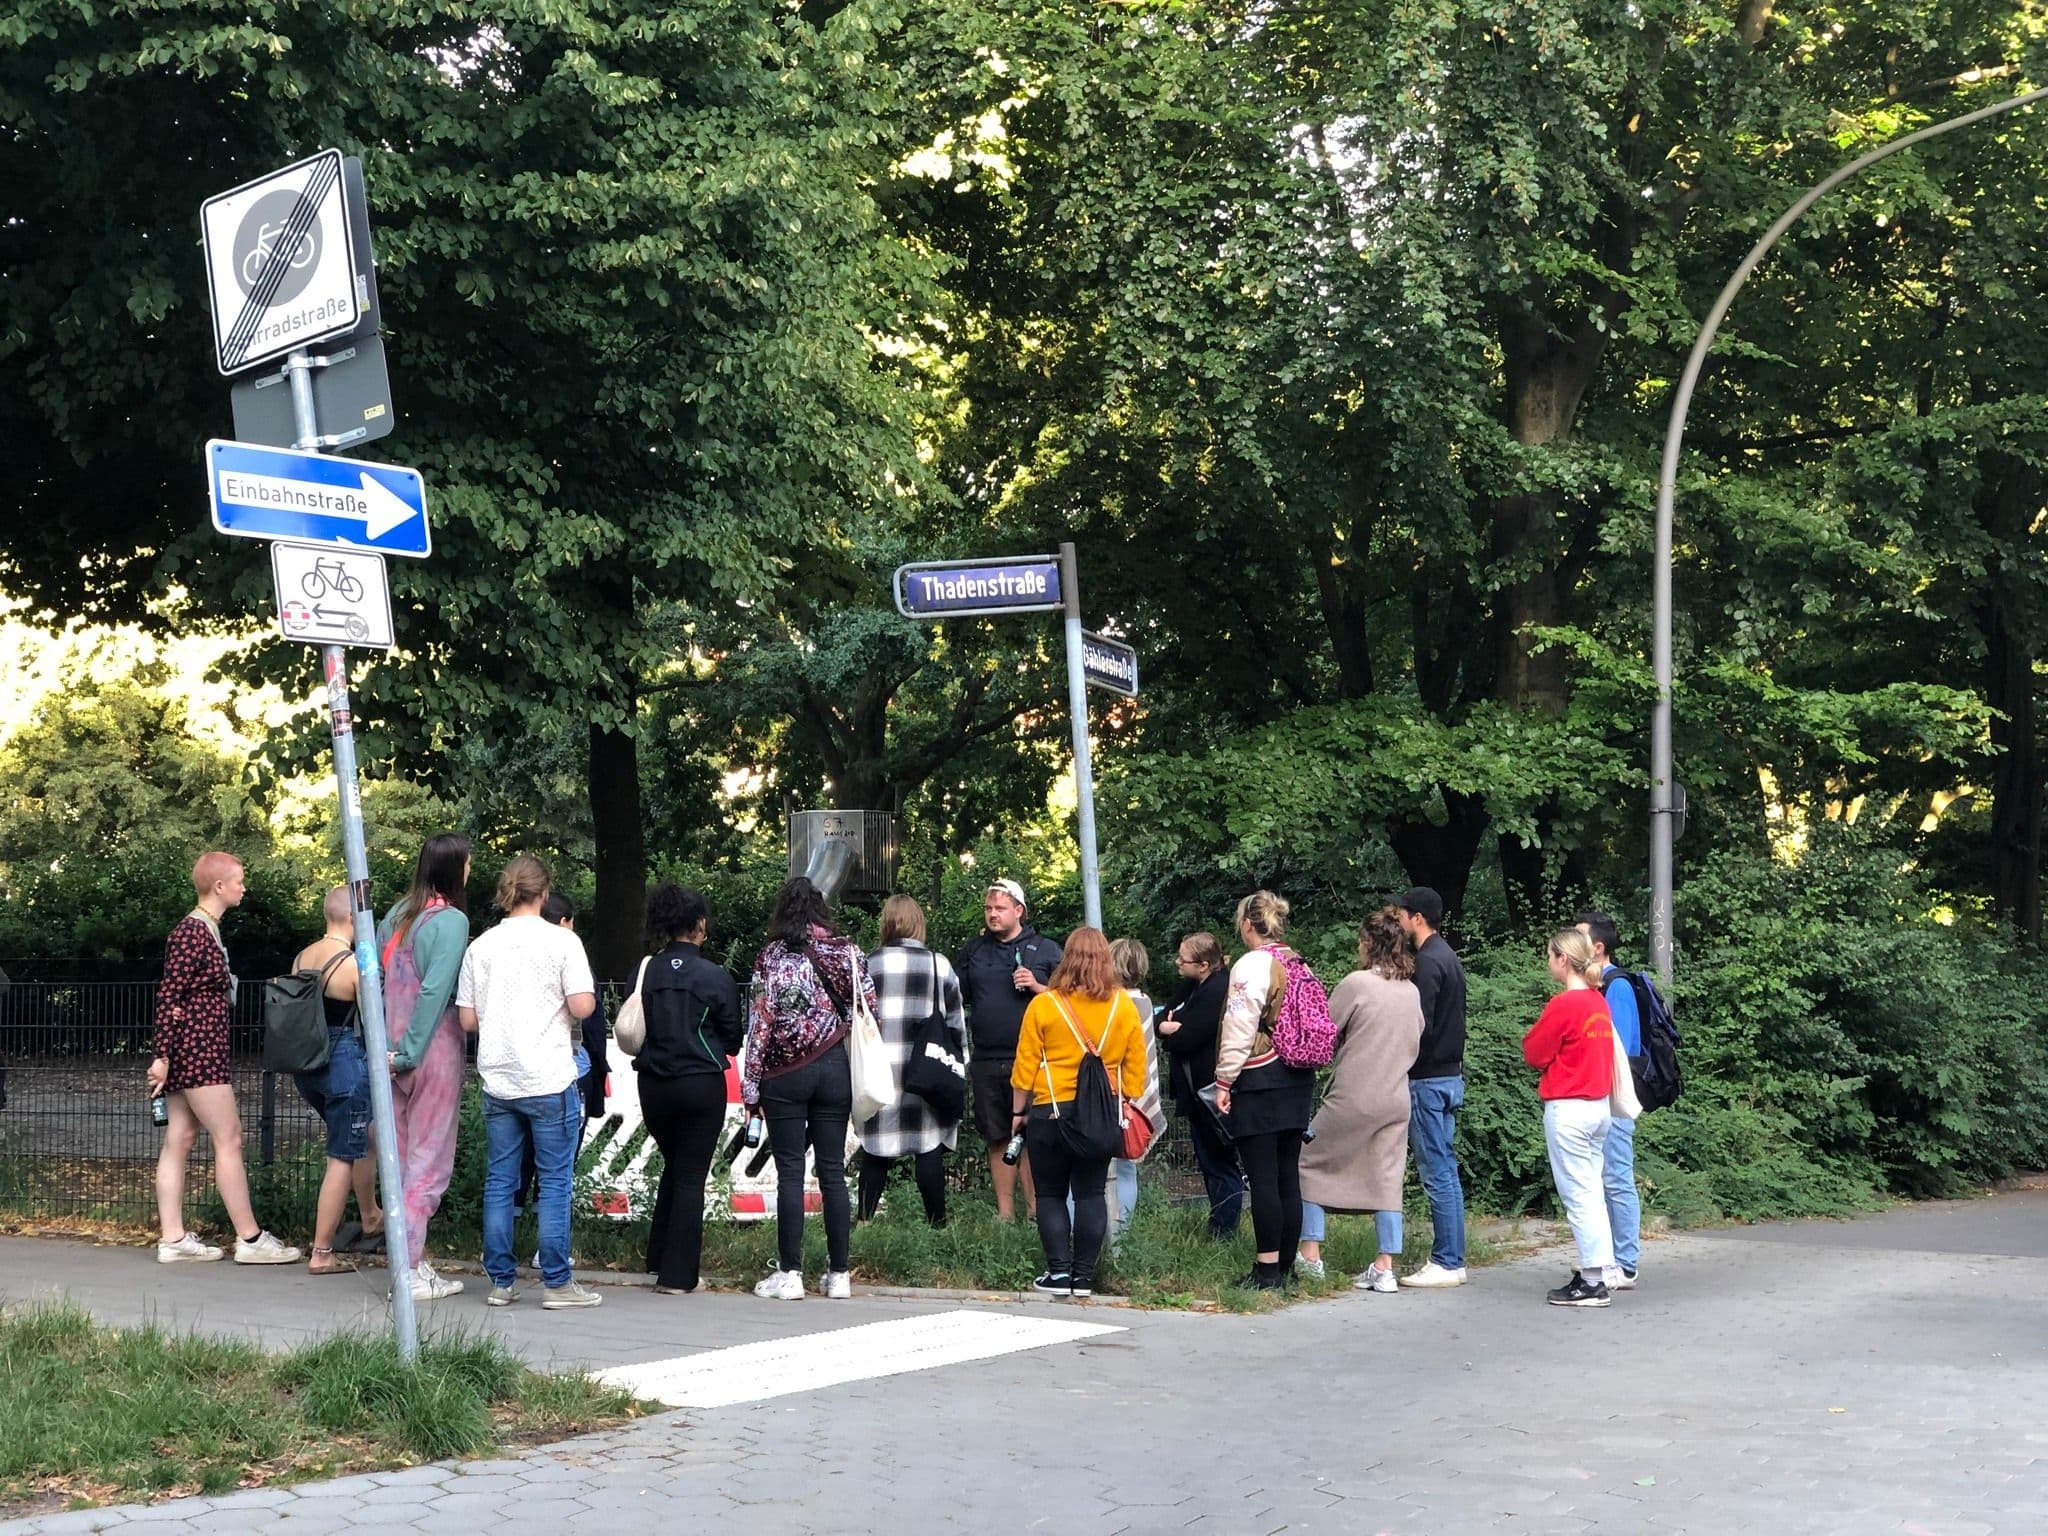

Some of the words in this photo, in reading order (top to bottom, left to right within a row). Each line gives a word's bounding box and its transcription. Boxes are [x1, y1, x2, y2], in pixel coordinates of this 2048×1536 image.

[240, 298, 347, 348] rradstraße
[226, 479, 368, 514] Einbahnstraße
[921, 570, 1046, 601] Thadenstraße
